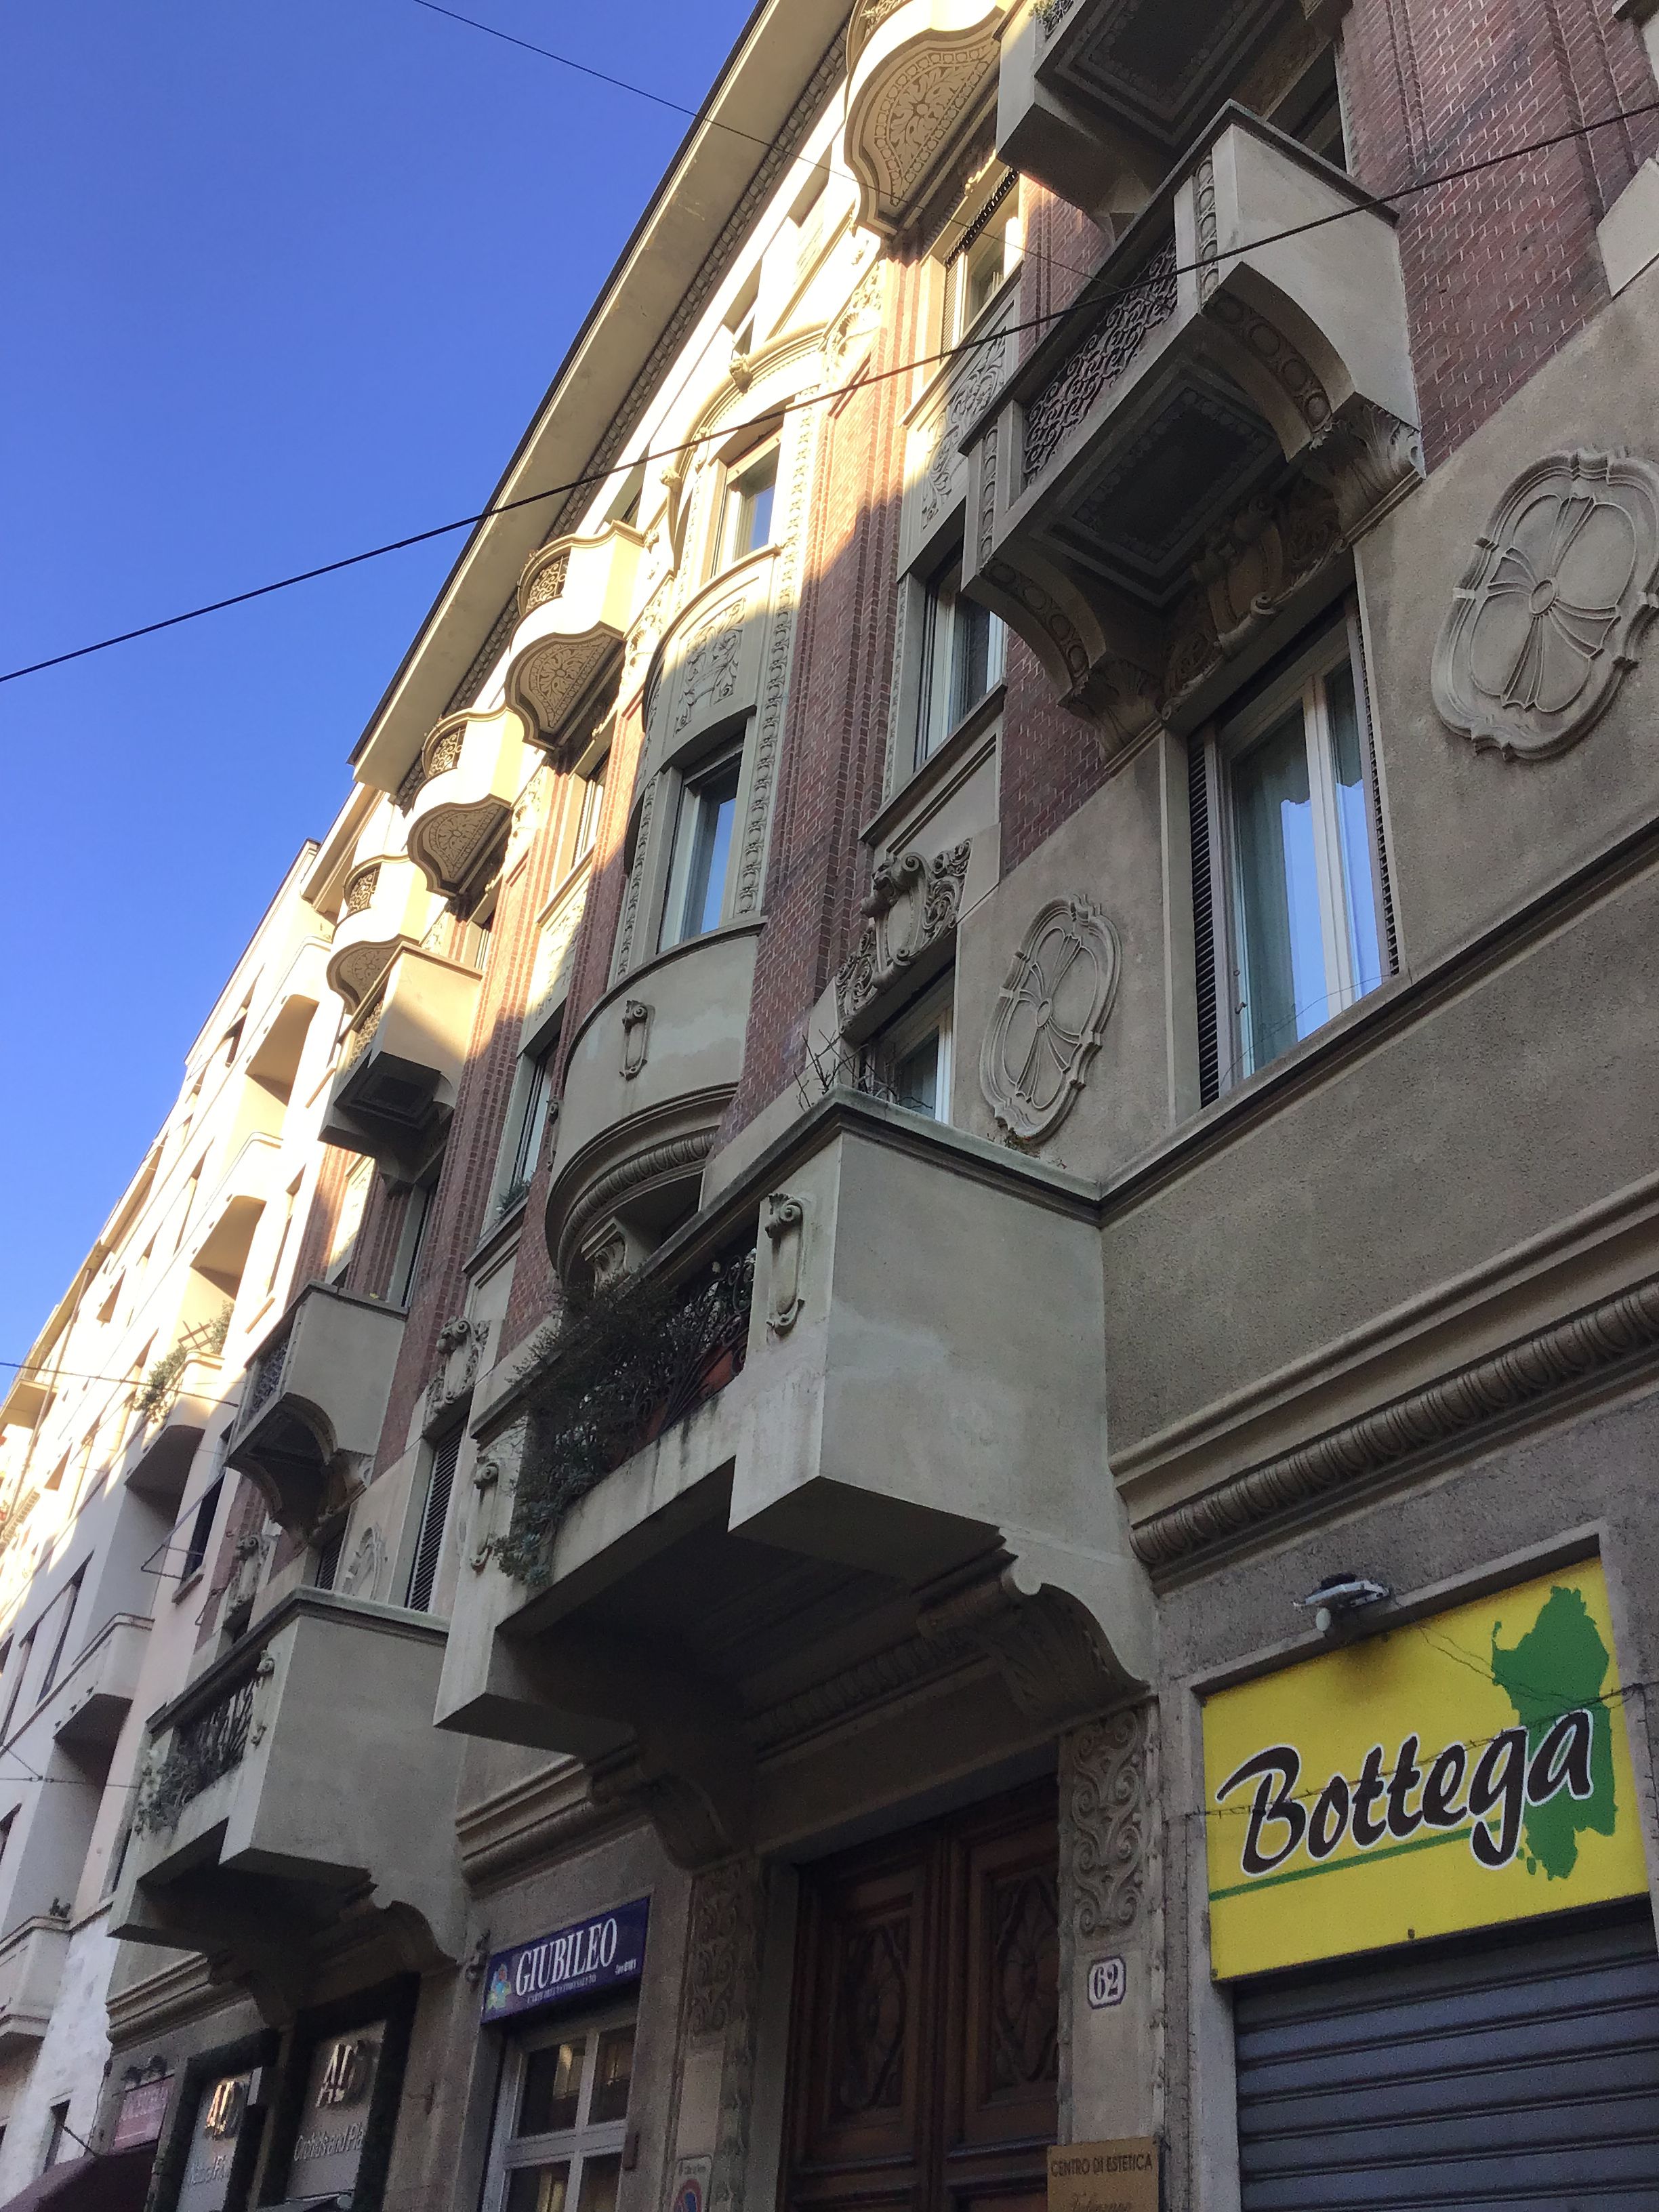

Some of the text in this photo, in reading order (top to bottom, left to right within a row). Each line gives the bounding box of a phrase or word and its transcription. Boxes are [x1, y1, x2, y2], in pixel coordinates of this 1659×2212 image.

[1216, 1708, 1594, 1877] Bottega
[515, 1917, 617, 1996] GIUBILEO
[1093, 1963, 1119, 2000] 62
[1050, 2153, 1153, 2177] CENTRO DI ESTETICA
